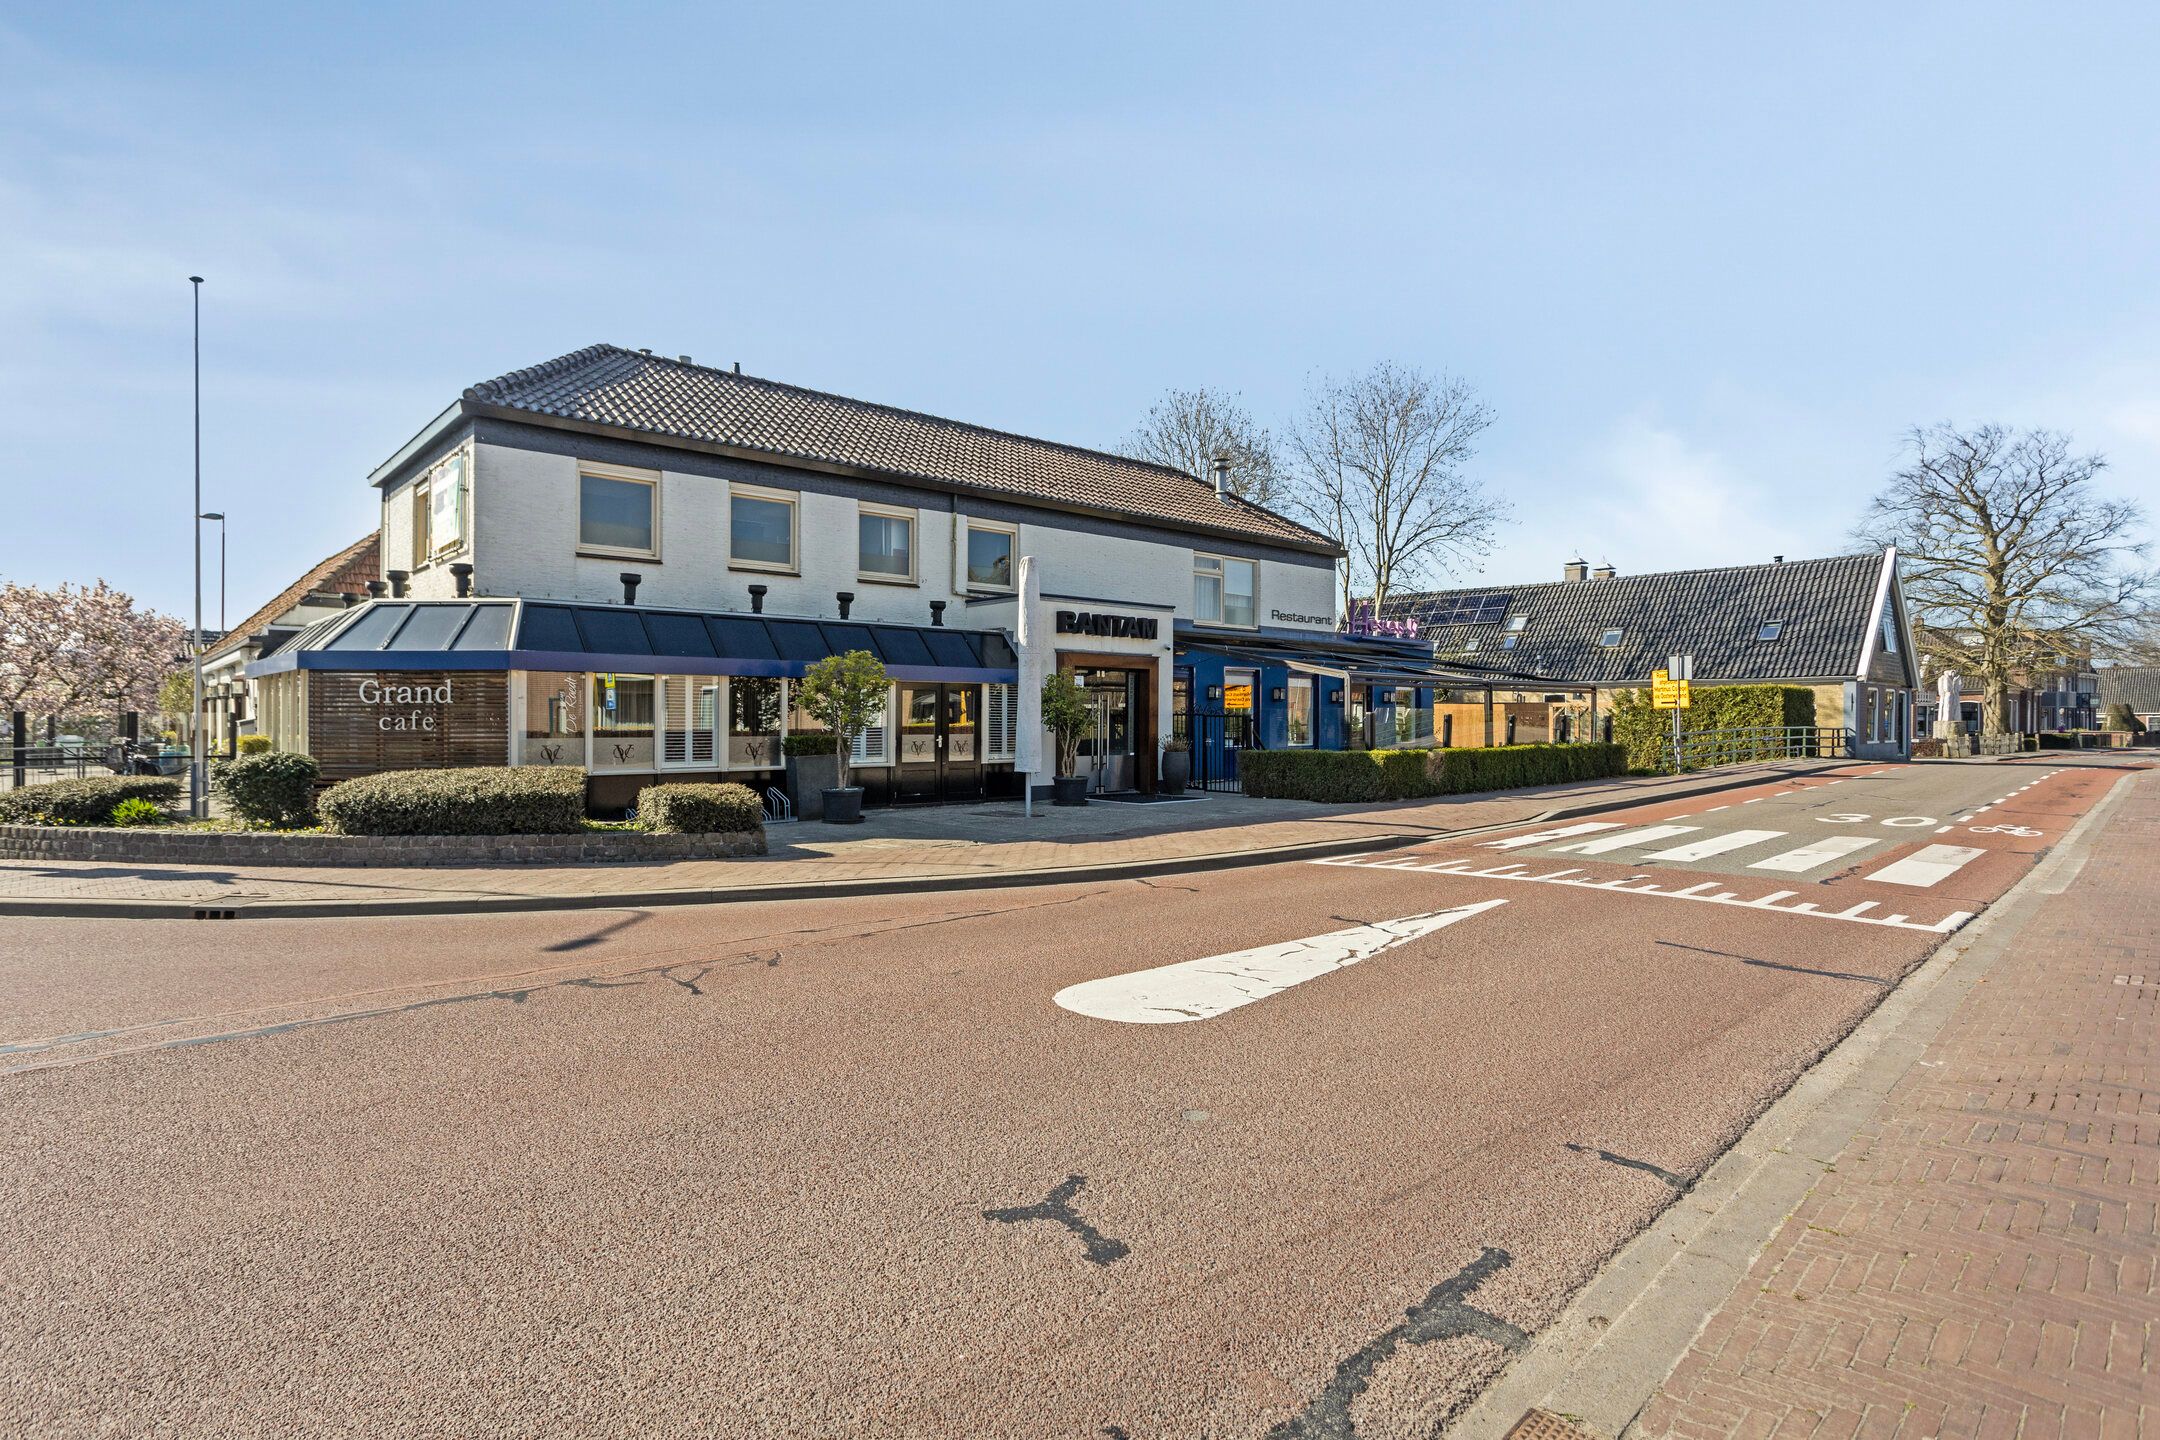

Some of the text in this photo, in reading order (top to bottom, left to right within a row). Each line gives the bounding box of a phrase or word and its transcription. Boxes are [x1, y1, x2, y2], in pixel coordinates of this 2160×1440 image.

[1056, 610, 1158, 639] BANTAM
[1271, 609, 1333, 626] Restaurant
[358, 678, 454, 704] Grand
[1815, 813, 1938, 827] 30
